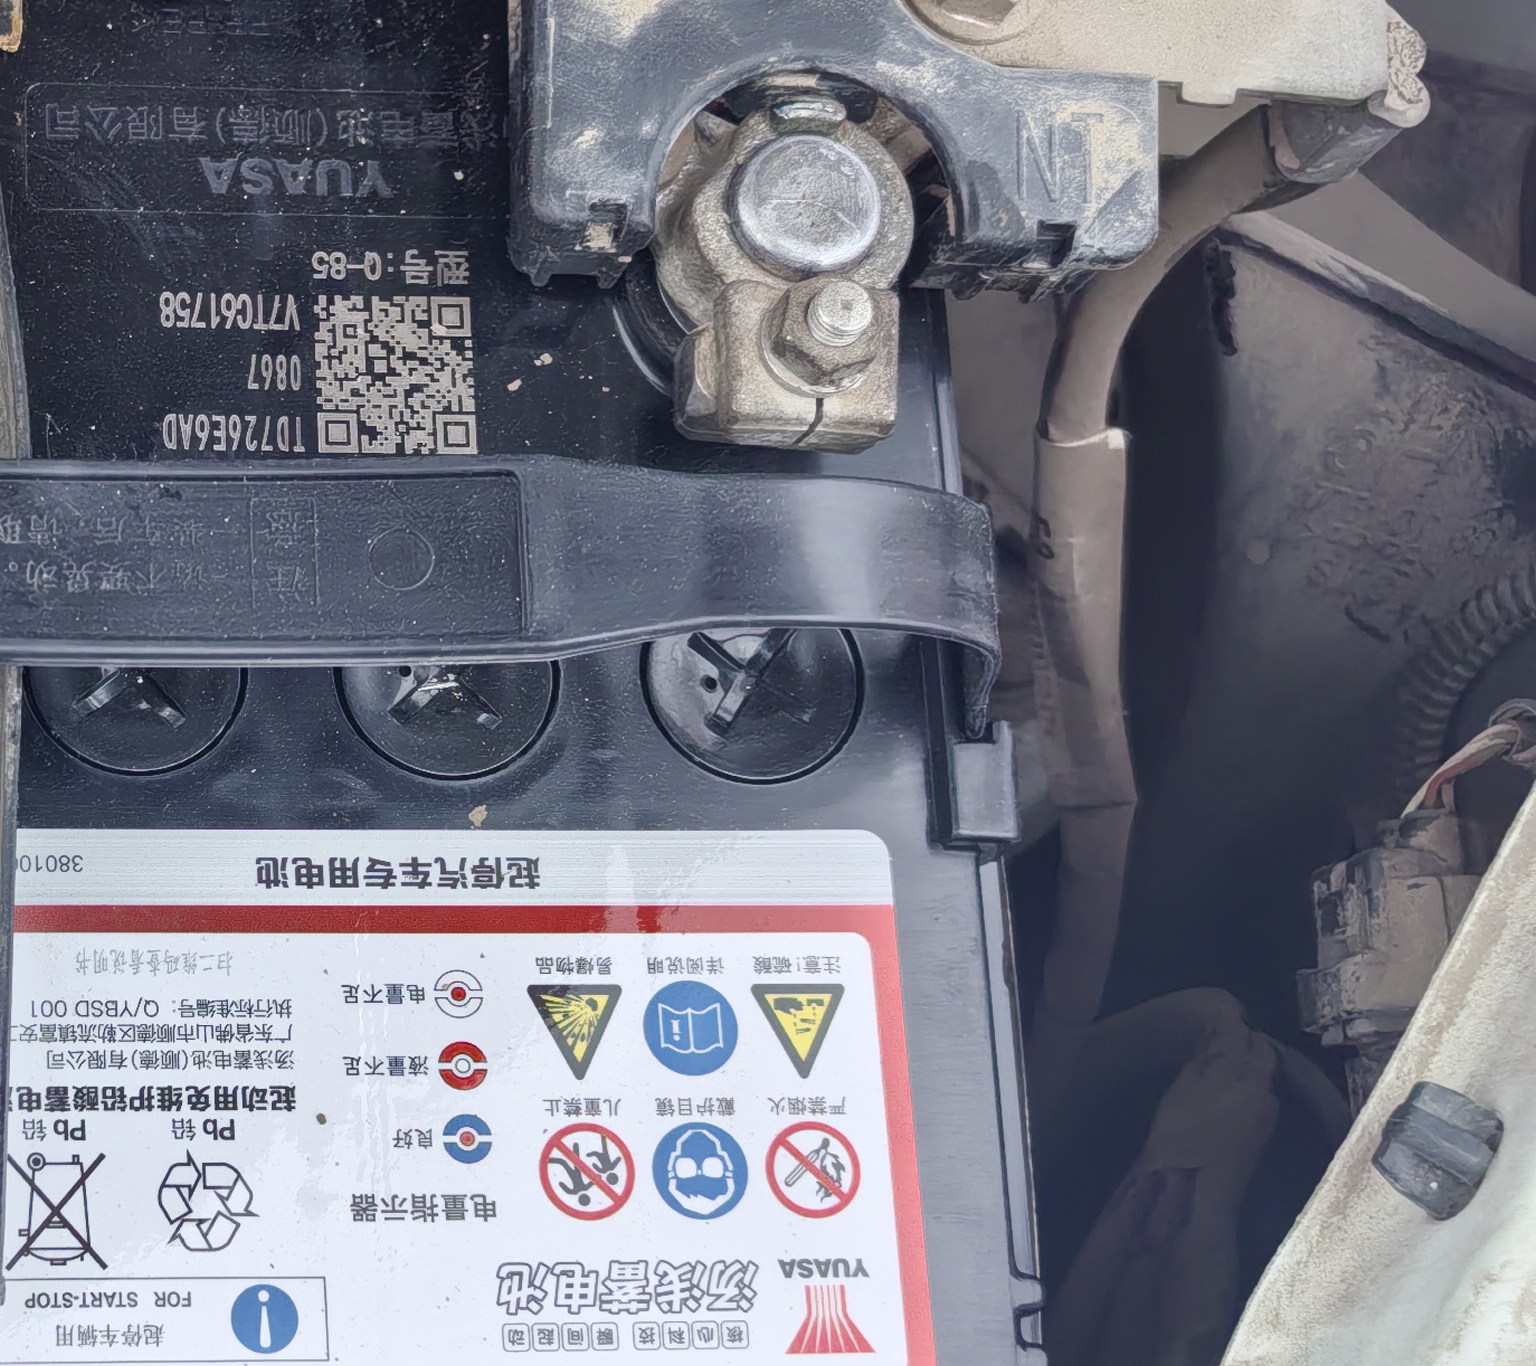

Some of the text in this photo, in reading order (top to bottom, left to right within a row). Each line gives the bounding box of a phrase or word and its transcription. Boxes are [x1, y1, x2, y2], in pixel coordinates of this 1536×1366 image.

[199, 158, 394, 197] YUASA
[159, 292, 300, 331] V7TC61758
[247, 353, 302, 391] 0867
[163, 413, 305, 452] TD726E6AD
[15, 854, 83, 873] 38010
[256, 857, 540, 889] 起停汽车专用电池
[74, 948, 232, 975] 扫二维码查看说明书
[536, 957, 612, 975] 易爆物品
[647, 956, 724, 974] 详阅说明
[341, 984, 425, 1004] 电量不足
[32, 1000, 67, 1017] 001
[75, 997, 159, 1017] Q/YBSD
[47, 1050, 294, 1070] 汤浅蓄电池(顺德)有限公司
[343, 1056, 428, 1076] 液量不足
[9, 1086, 296, 1112] 起动用免维护铅酸蓄电
[543, 1098, 621, 1117] 儿童禁止
[655, 1097, 735, 1117] 戴护目镜
[767, 1097, 846, 1115] 严禁烟火
[22, 1119, 86, 1141] Pb 铅
[172, 1118, 235, 1141] Pb 铅
[393, 1129, 432, 1149] 良好
[350, 1194, 496, 1222] 电量指示器
[778, 1258, 869, 1279] YUASA
[496, 1259, 759, 1316] 汤浅蓄电池
[25, 1291, 191, 1308] FOR START-STOP
[56, 1324, 163, 1347] 起停车辆用
[634, 1322, 747, 1348] 核心科技
